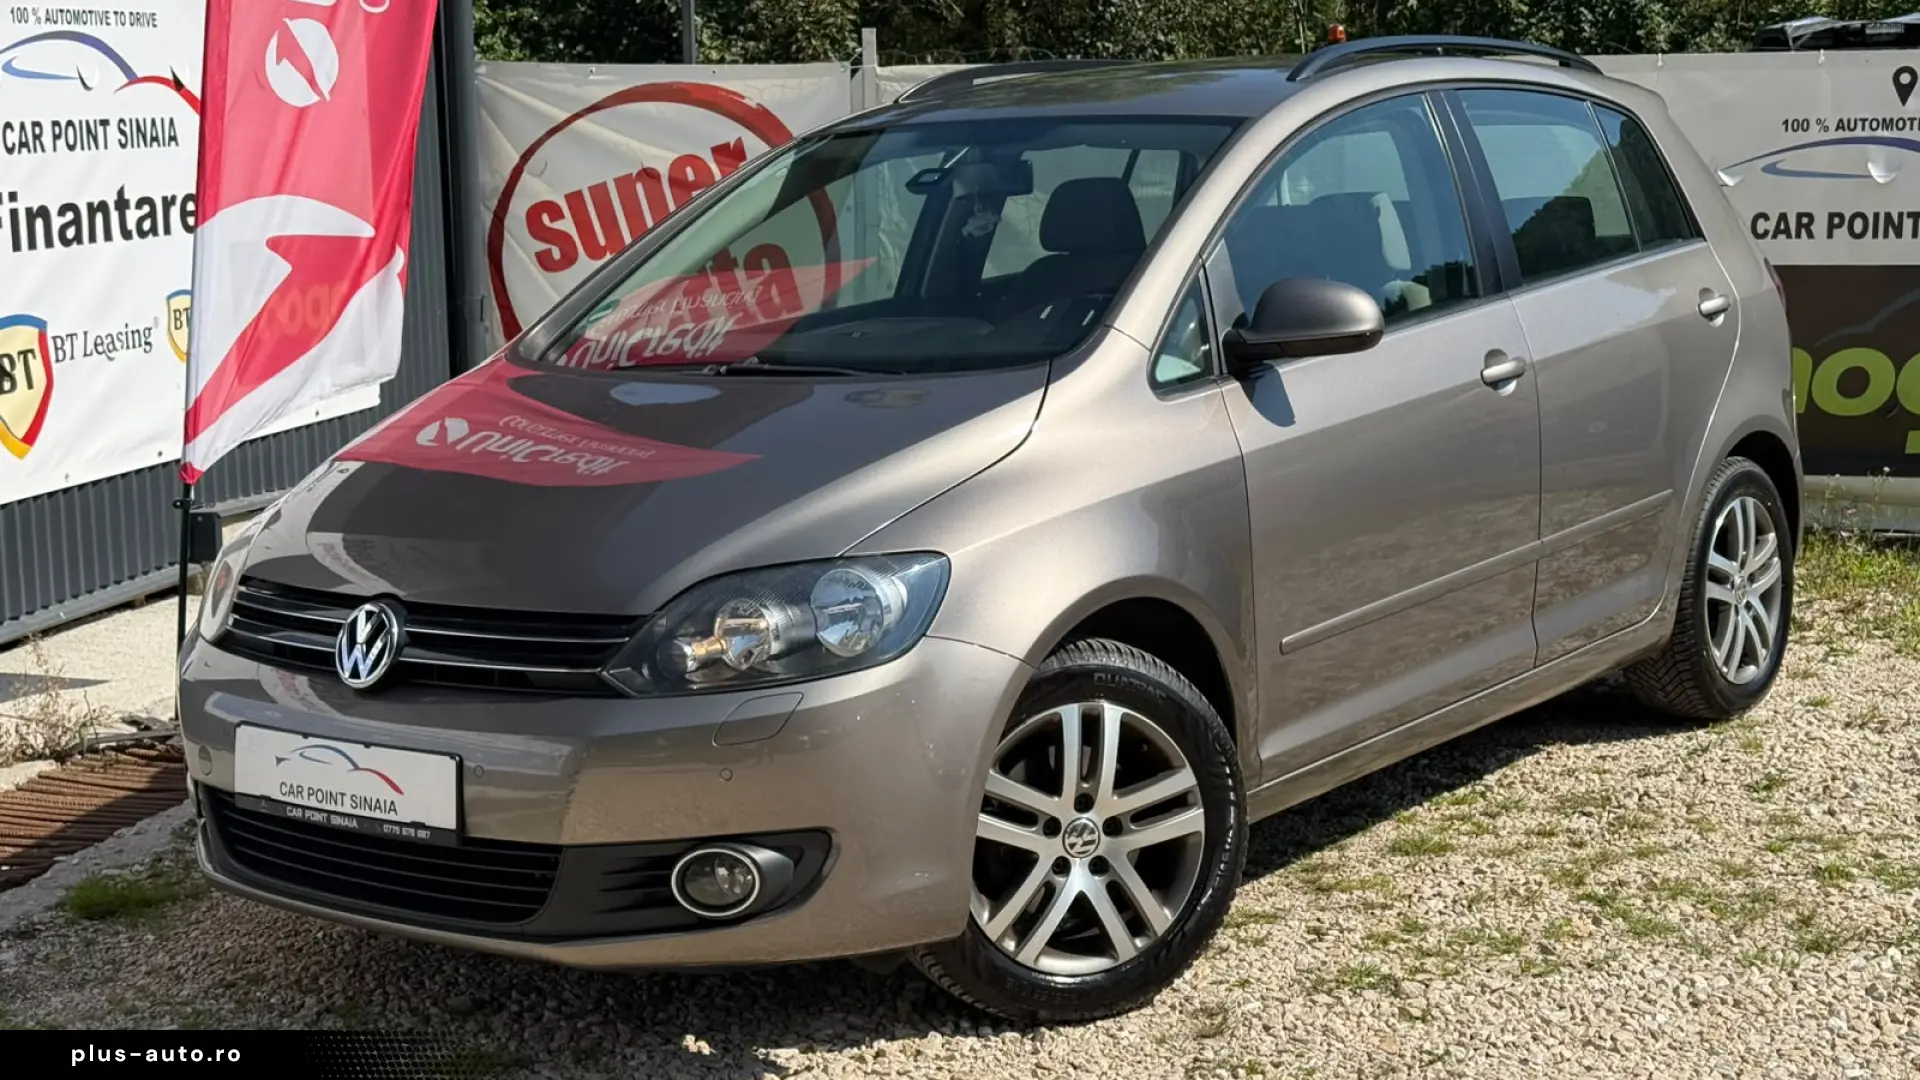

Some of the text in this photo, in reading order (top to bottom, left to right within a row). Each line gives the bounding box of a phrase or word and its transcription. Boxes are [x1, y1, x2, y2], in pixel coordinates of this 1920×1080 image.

[10, 7, 158, 28] 100 % AUTOMOTIVE TO DRIVE
[2, 116, 180, 155] CAR POINT SINAIA
[1782, 118, 1810, 133] 100
[1816, 117, 1830, 133] %
[0, 183, 197, 253] inantare
[1750, 210, 1920, 240] CAR POINT
[51, 332, 79, 364] BT
[279, 780, 399, 817] CAR POINT SINAIA
[286, 806, 304, 818] CAR
[304, 809, 329, 824] POINT
[329, 814, 359, 829] SINAIA
